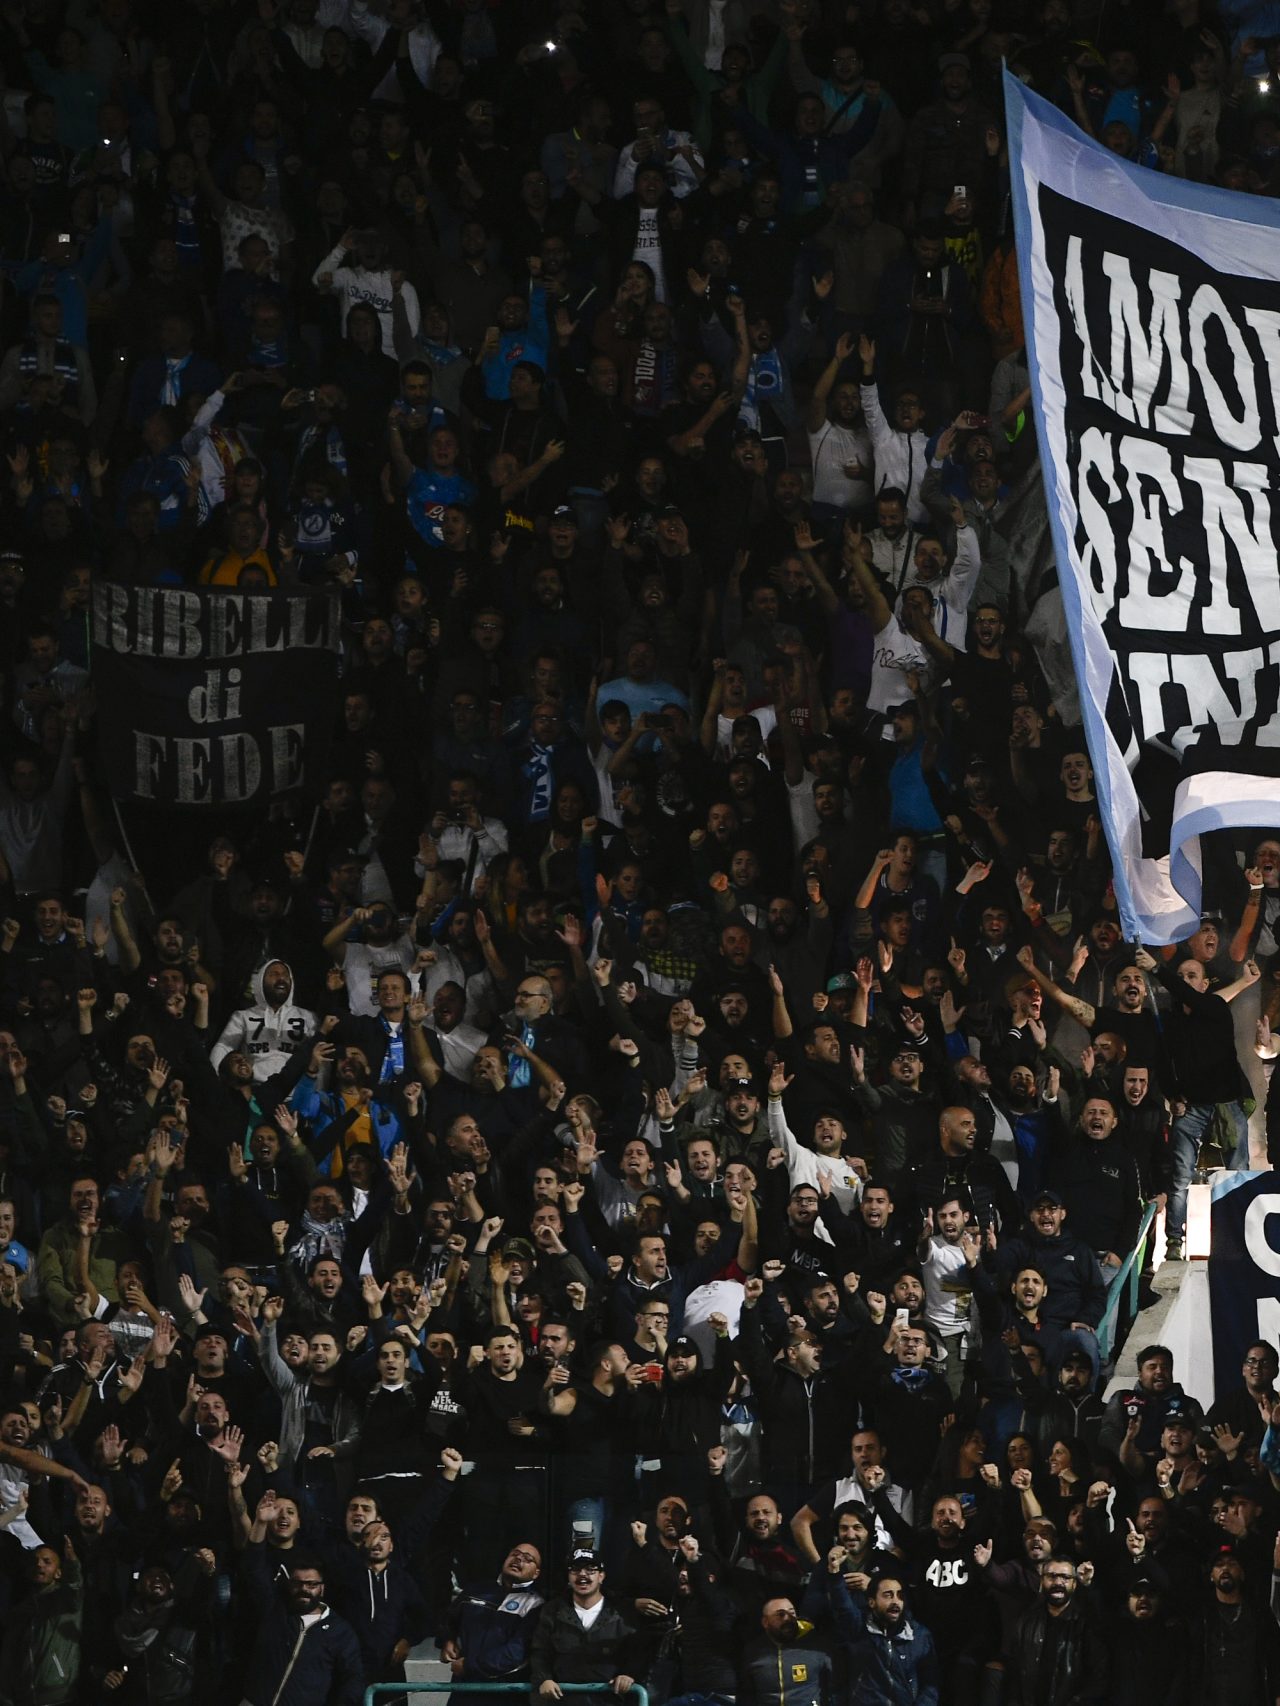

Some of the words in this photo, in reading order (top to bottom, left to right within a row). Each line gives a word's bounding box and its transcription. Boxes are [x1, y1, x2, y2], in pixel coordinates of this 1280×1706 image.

[93, 581, 342, 660] RIBELLI
[187, 667, 243, 725] di
[132, 724, 305, 804] FEDE
[248, 1017, 266, 1041] 7
[287, 1017, 305, 1041] 3
